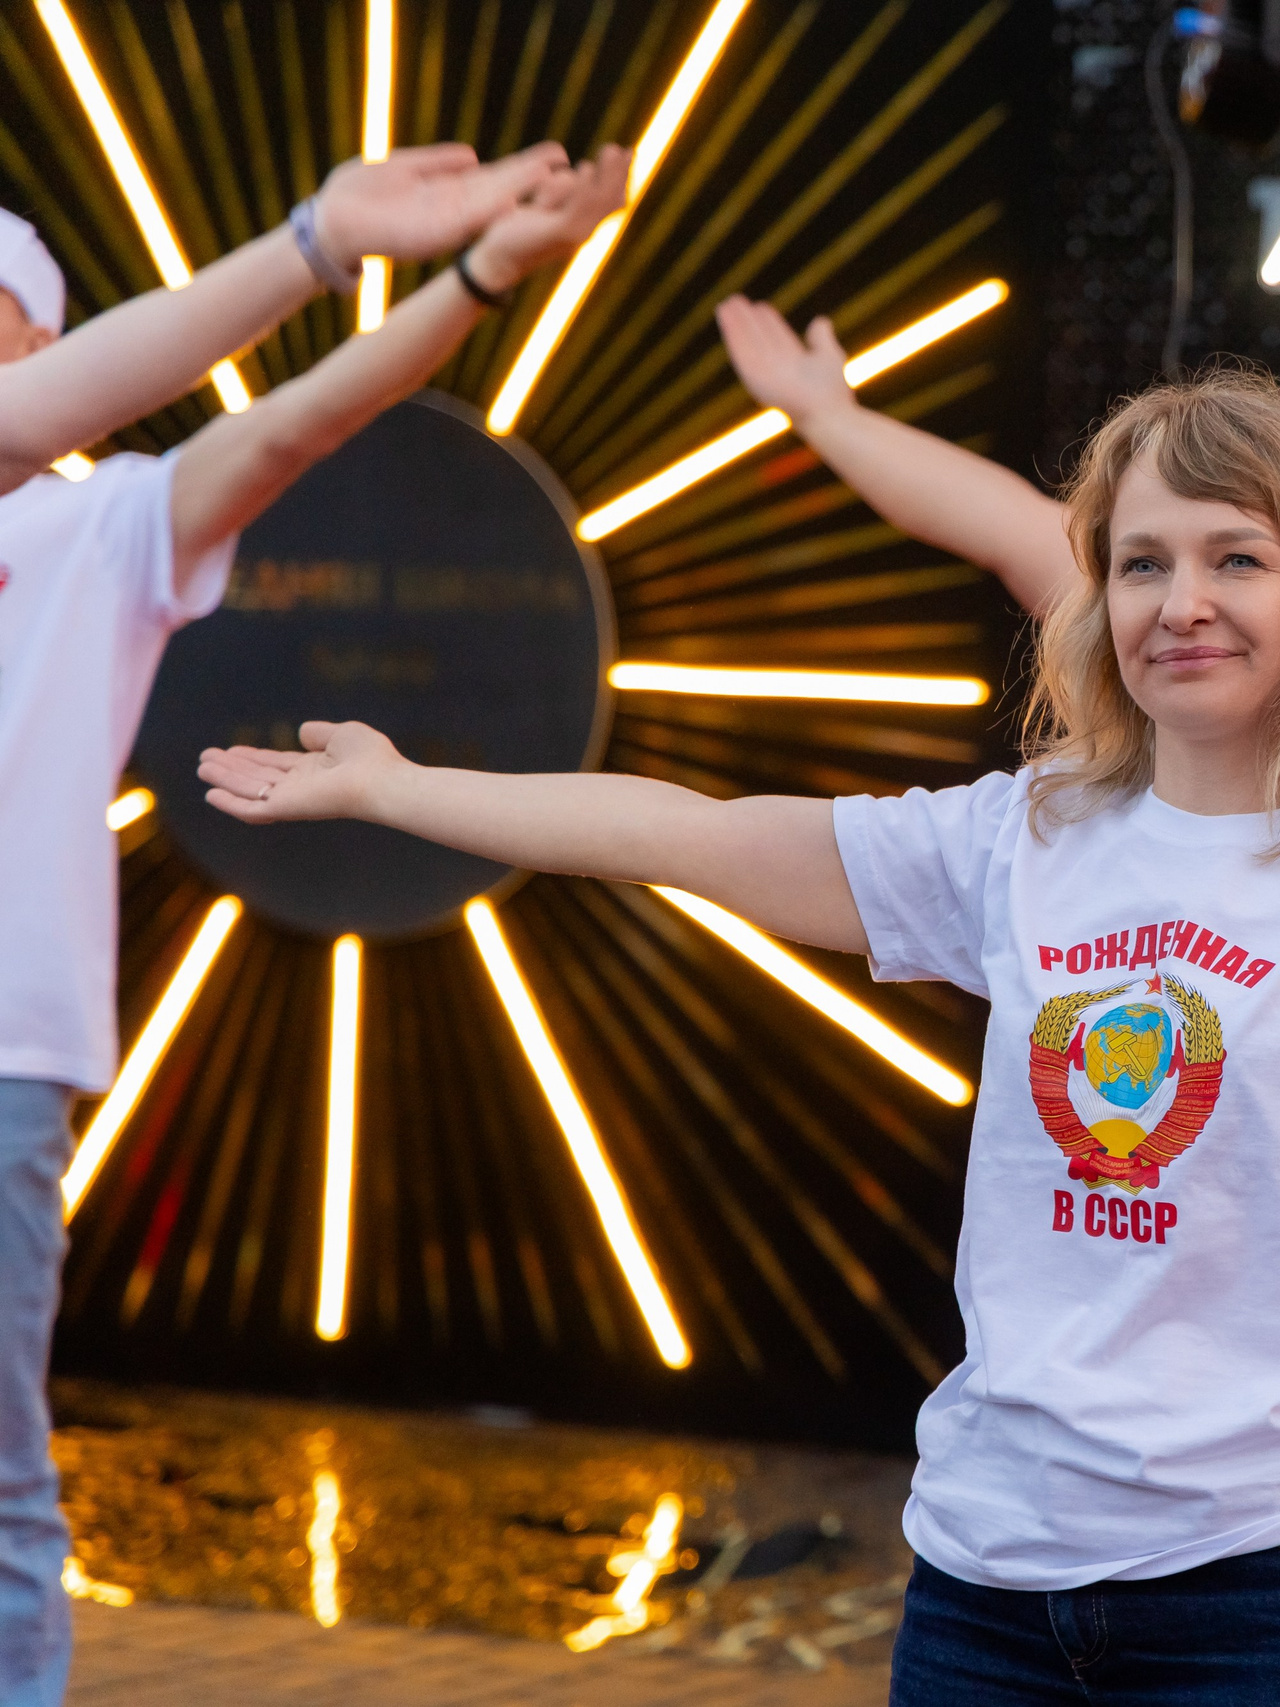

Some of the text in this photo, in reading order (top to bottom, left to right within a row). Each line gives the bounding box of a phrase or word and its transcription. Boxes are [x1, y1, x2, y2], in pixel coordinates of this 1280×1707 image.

[1037, 919, 1276, 989] РОЖДЕННАЯ
[1052, 1189, 1178, 1245] В СССР
